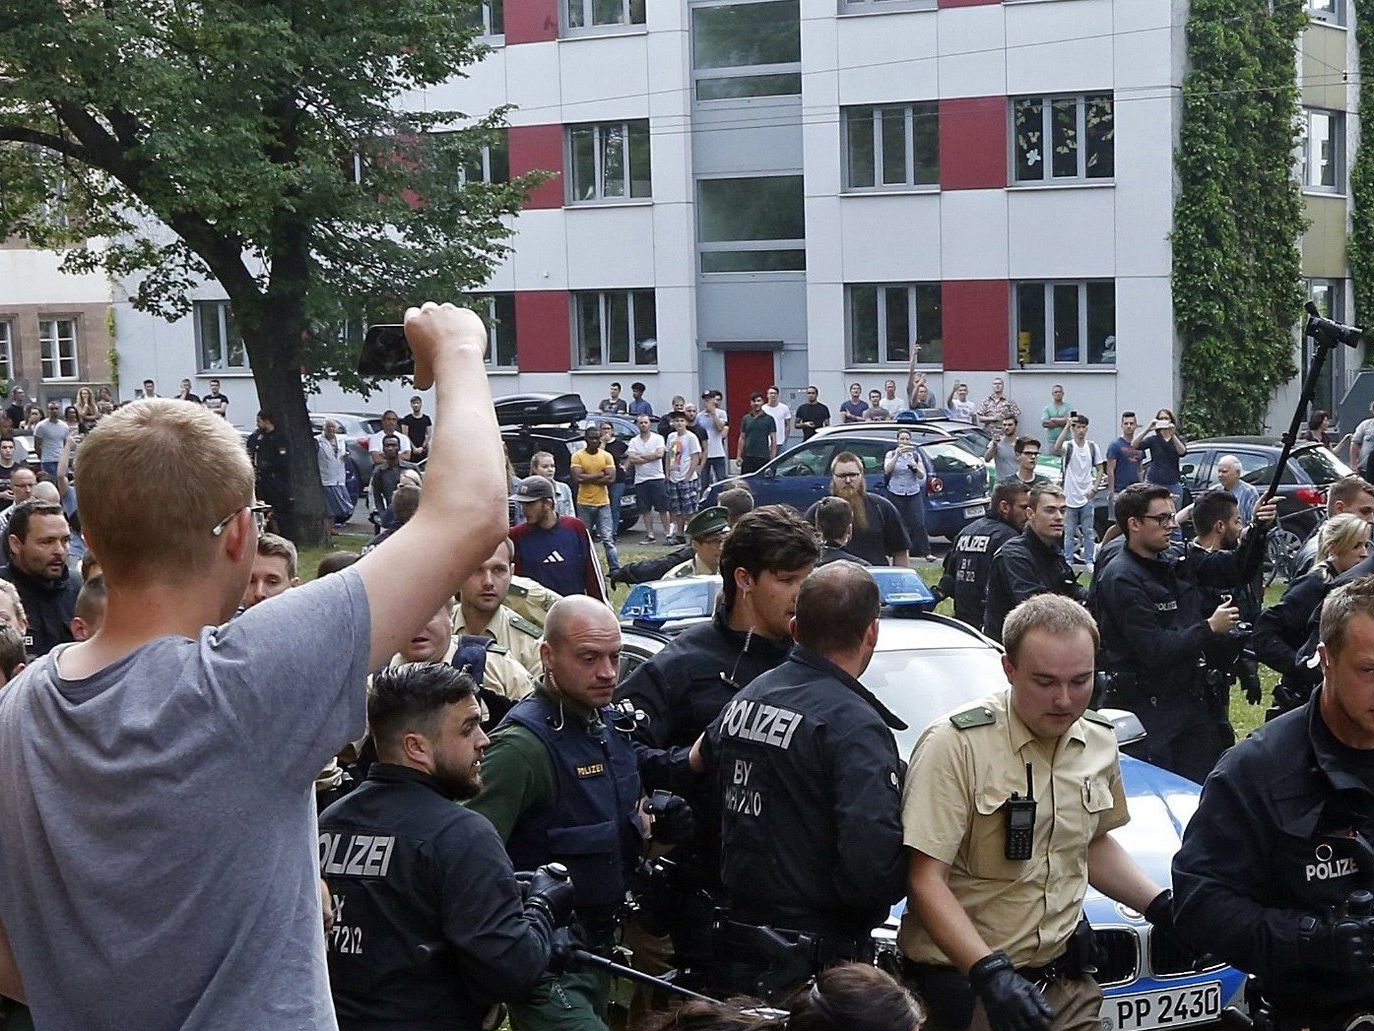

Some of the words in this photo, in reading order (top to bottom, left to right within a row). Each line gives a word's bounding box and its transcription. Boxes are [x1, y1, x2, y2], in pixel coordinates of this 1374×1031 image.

[955, 535, 991, 552] POLIZEI
[719, 699, 804, 750] POLIZEI
[733, 759, 753, 786] BY
[318, 832, 396, 877] OLIZEI
[1305, 857, 1360, 882] POLIZE
[1116, 998, 1151, 1029] PP
[1157, 987, 1219, 1024] 2430
